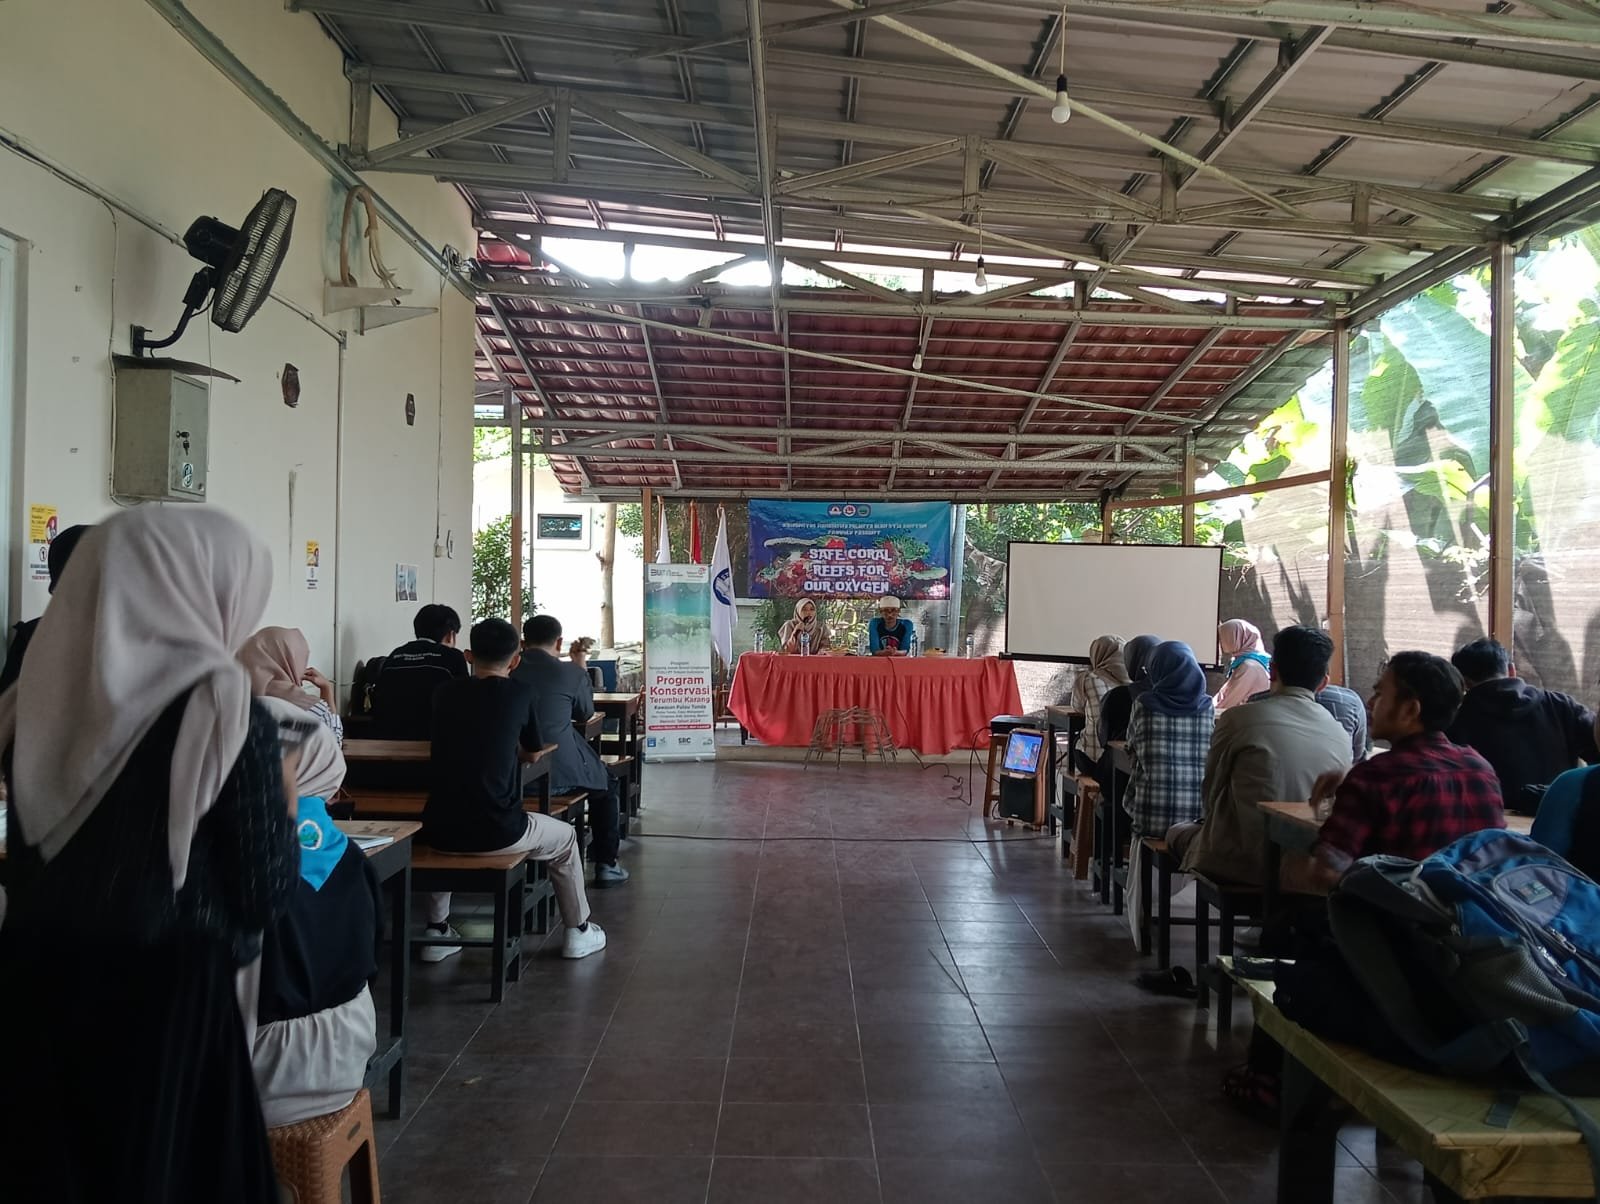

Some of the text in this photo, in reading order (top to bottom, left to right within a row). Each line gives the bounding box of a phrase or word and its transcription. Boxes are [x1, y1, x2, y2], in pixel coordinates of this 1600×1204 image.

[809, 548, 892, 561] SAFE CORAL
[813, 565, 889, 577] REEFS FOR
[804, 580, 890, 594] OUR OXYGEN
[656, 676, 704, 687] Program
[650, 685, 710, 696] Konservasi
[685, 696, 711, 704] Karang
